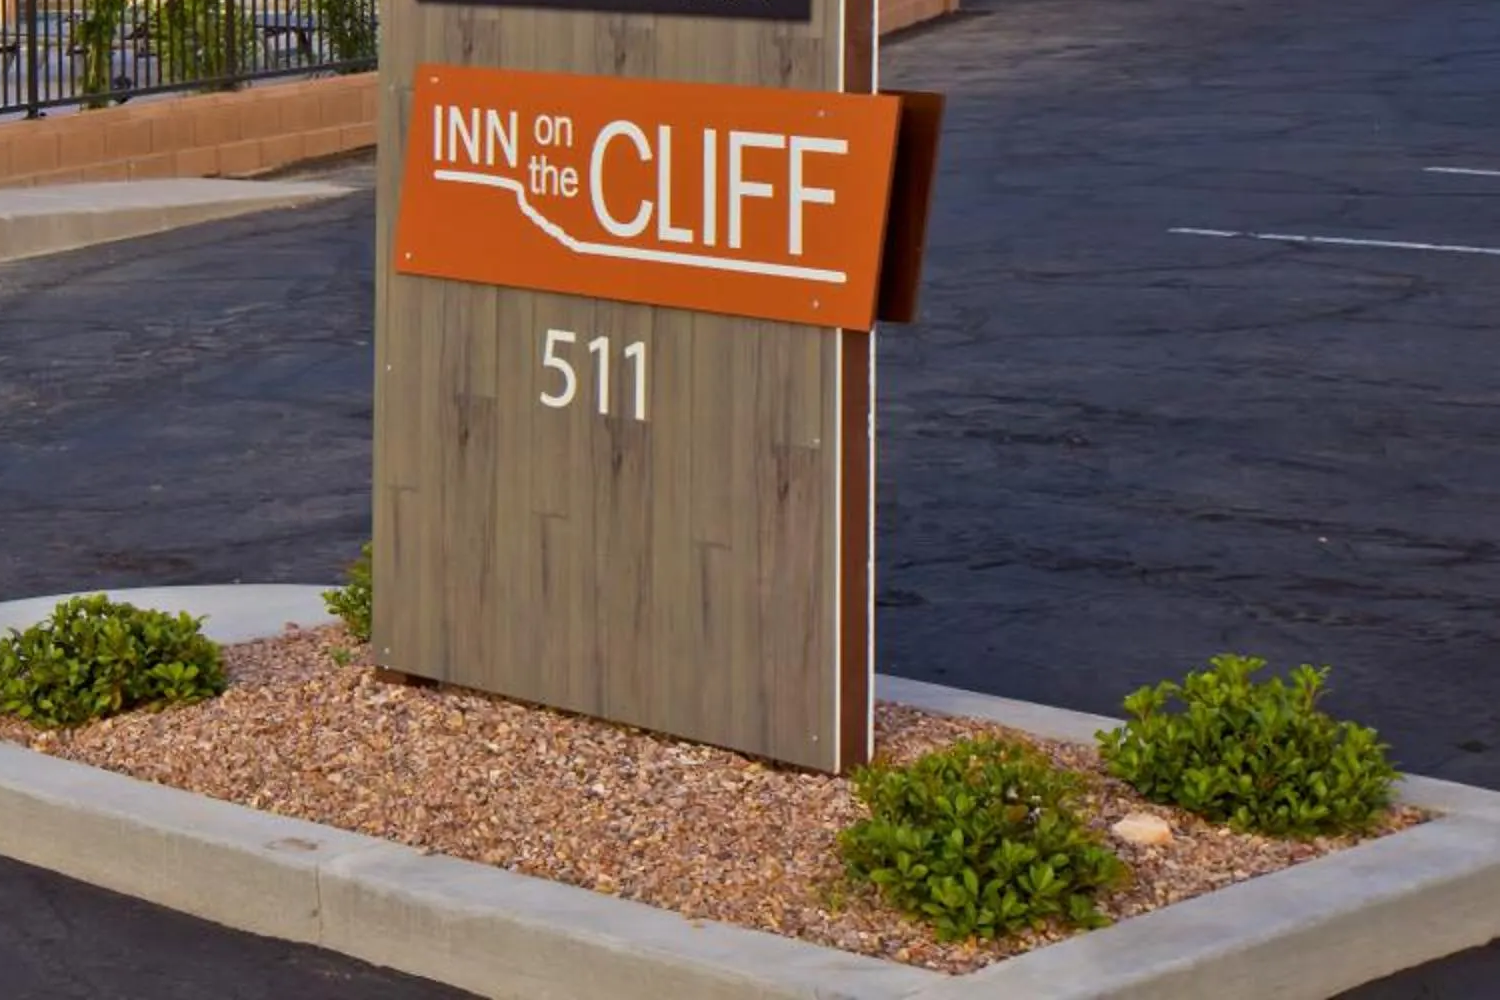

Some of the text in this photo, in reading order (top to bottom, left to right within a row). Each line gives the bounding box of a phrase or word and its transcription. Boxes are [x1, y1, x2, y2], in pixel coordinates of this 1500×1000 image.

[433, 105, 849, 255] INN on the CLIFF
[540, 329, 646, 421] 511
